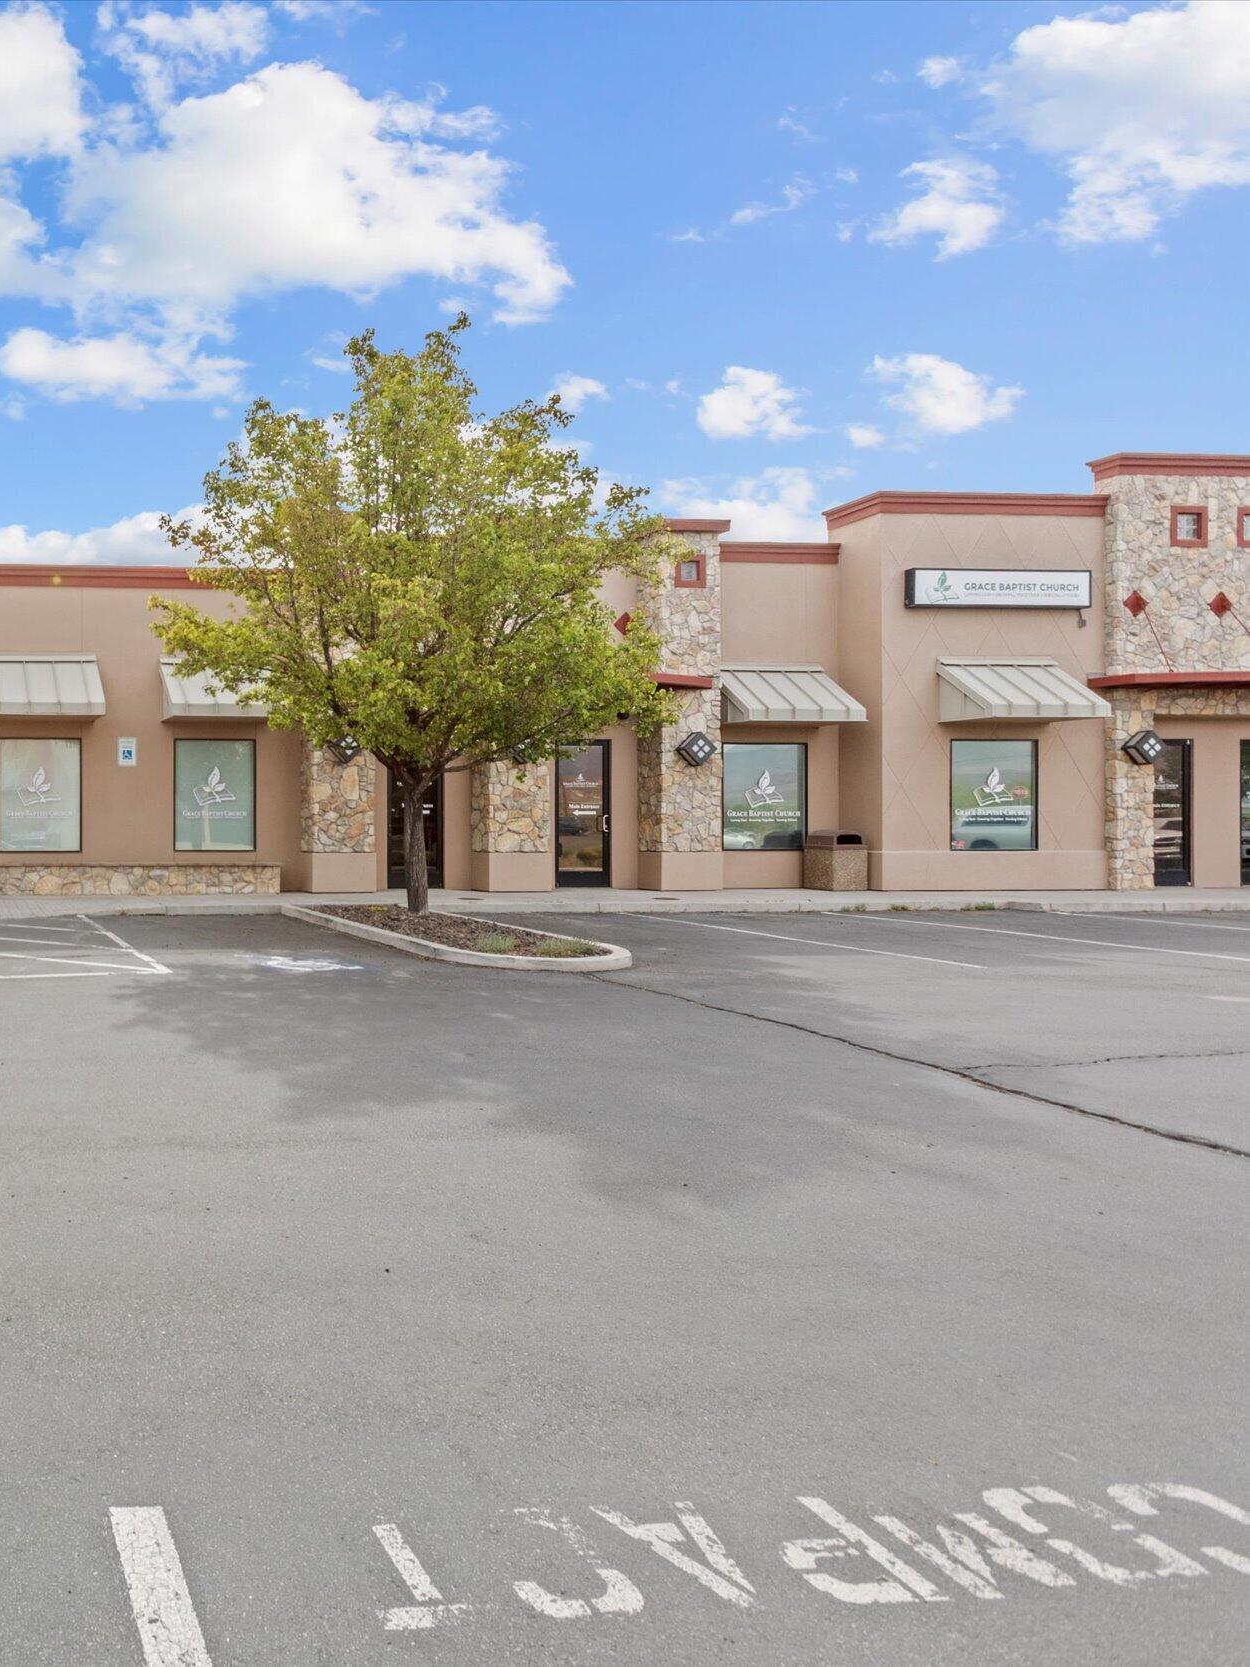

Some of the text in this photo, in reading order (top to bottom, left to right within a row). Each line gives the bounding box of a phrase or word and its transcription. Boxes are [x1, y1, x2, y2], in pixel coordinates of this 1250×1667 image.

[964, 582, 1079, 592] GRACE BAPTIST CHURCH
[727, 809, 801, 817] GRACE BAPTIST CHURCH
[954, 808, 1031, 816] GRACE BAPTIST CHURCH
